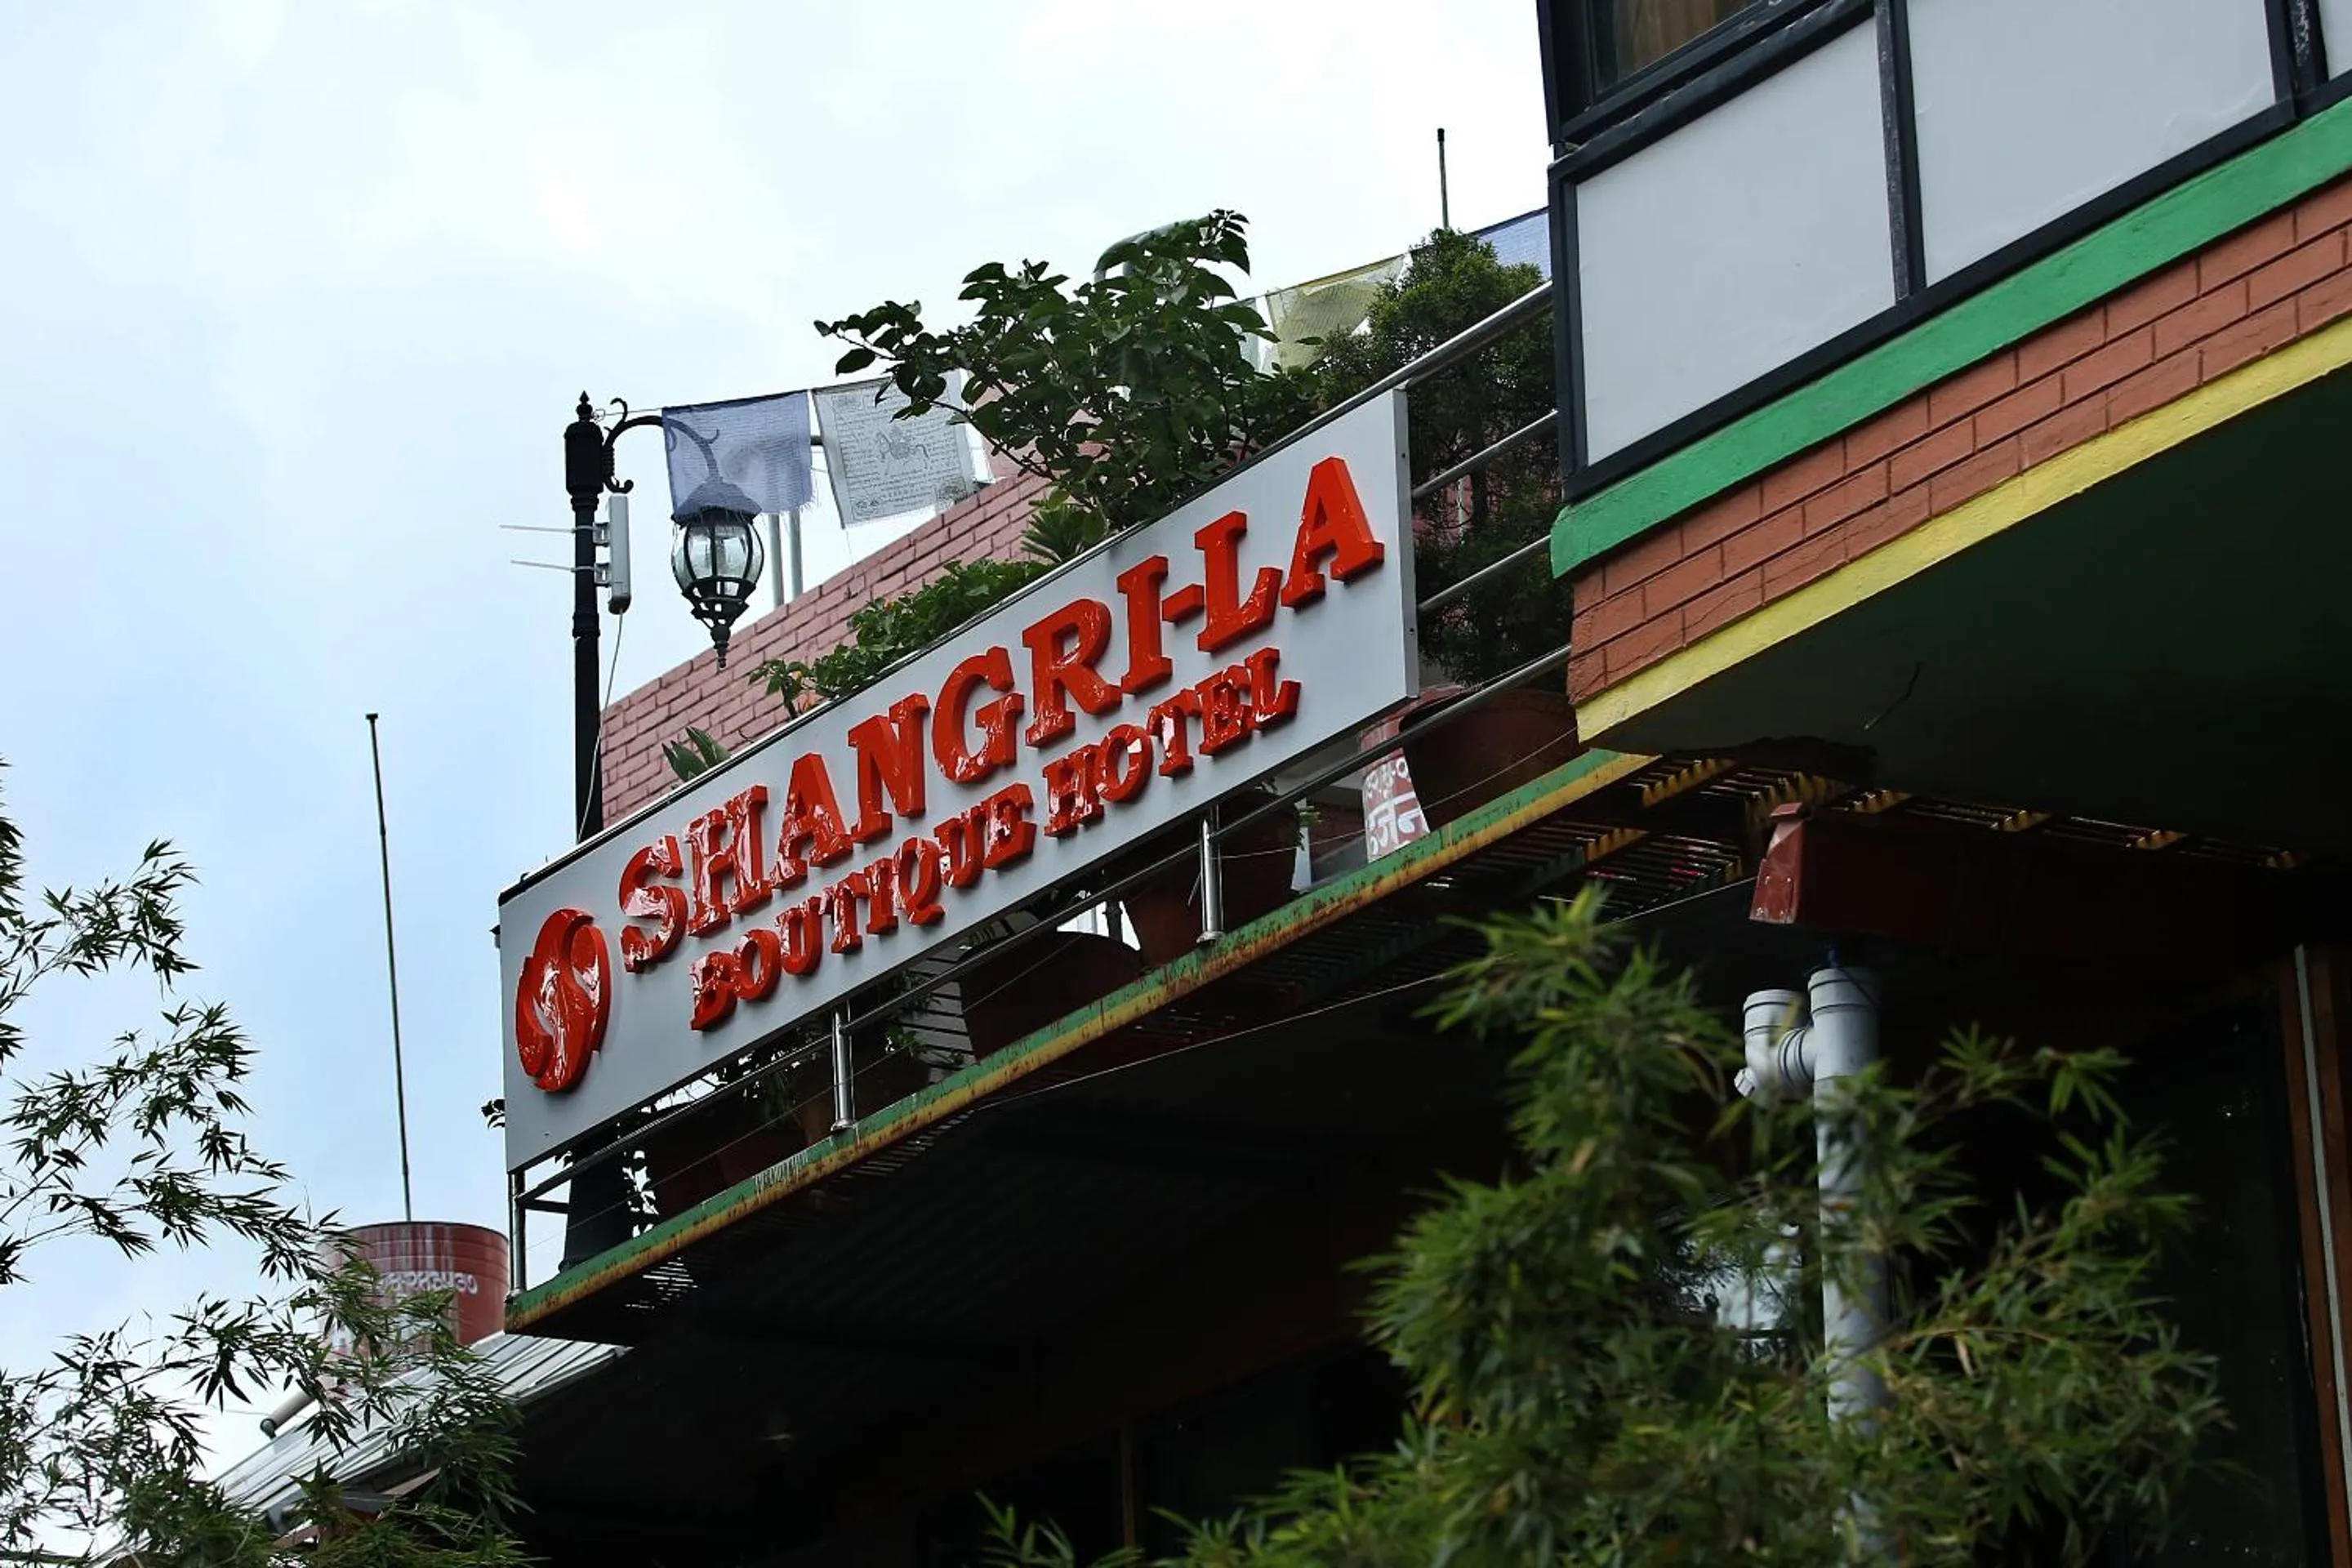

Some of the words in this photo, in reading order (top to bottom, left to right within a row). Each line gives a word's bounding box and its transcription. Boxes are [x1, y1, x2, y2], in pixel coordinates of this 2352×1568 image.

[619, 456, 1386, 973] SHANGRI-LA
[690, 783, 1036, 1031] BOUTIQUE
[1043, 647, 1301, 837] HOTEL
